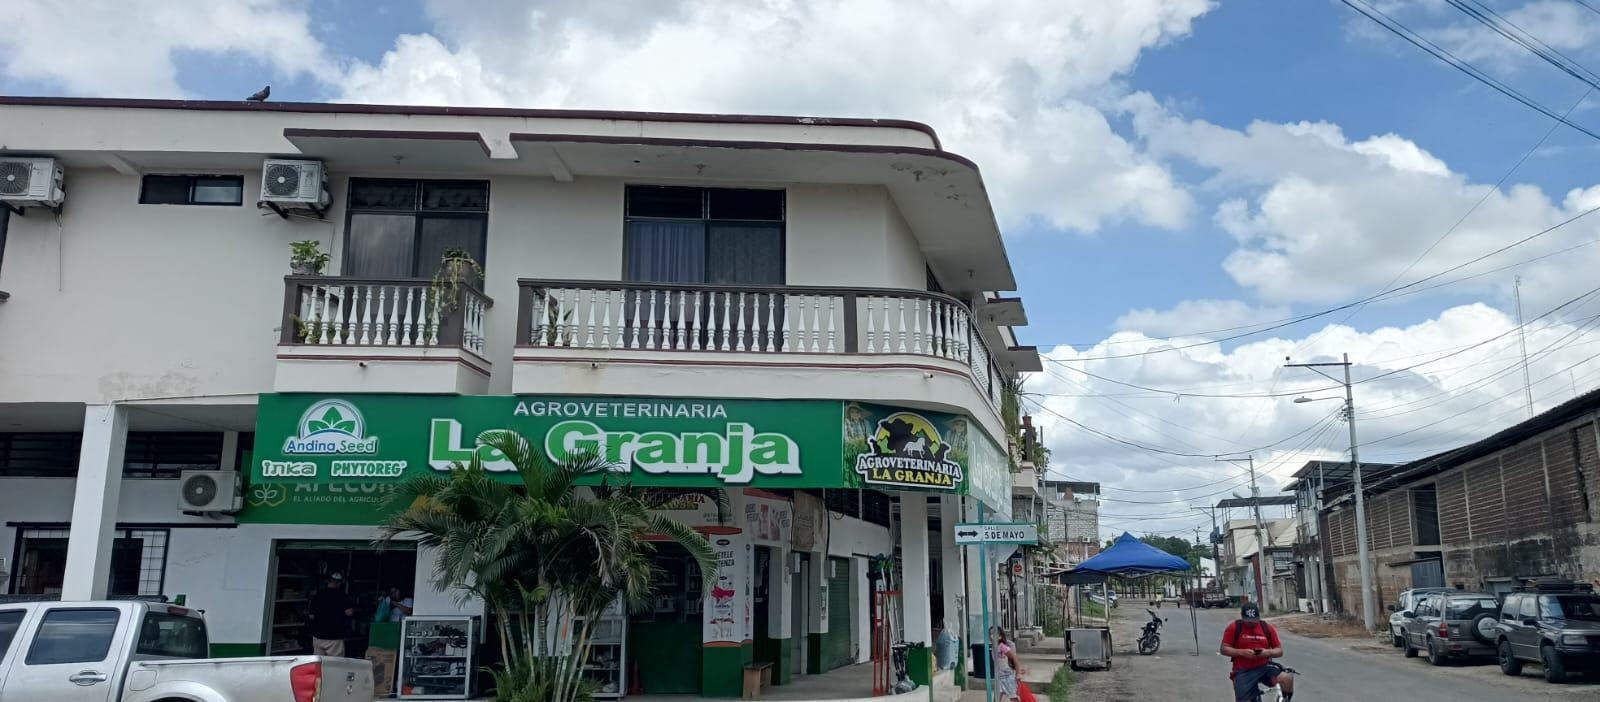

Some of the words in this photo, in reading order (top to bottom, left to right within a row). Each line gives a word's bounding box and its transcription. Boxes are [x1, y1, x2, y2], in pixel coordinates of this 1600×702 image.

[514, 401, 728, 418] AGROVETERINARIA
[287, 440, 338, 453] Andina
[343, 440, 378, 453] Seed
[430, 418, 530, 471] La
[546, 420, 802, 484] Granja
[859, 457, 960, 478] AGROVETERINARIA
[872, 468, 892, 481] LA
[894, 470, 952, 485] GRANJA
[984, 531, 990, 539] 5
[991, 531, 1001, 539] DE
[1003, 531, 1025, 540] MAYO
